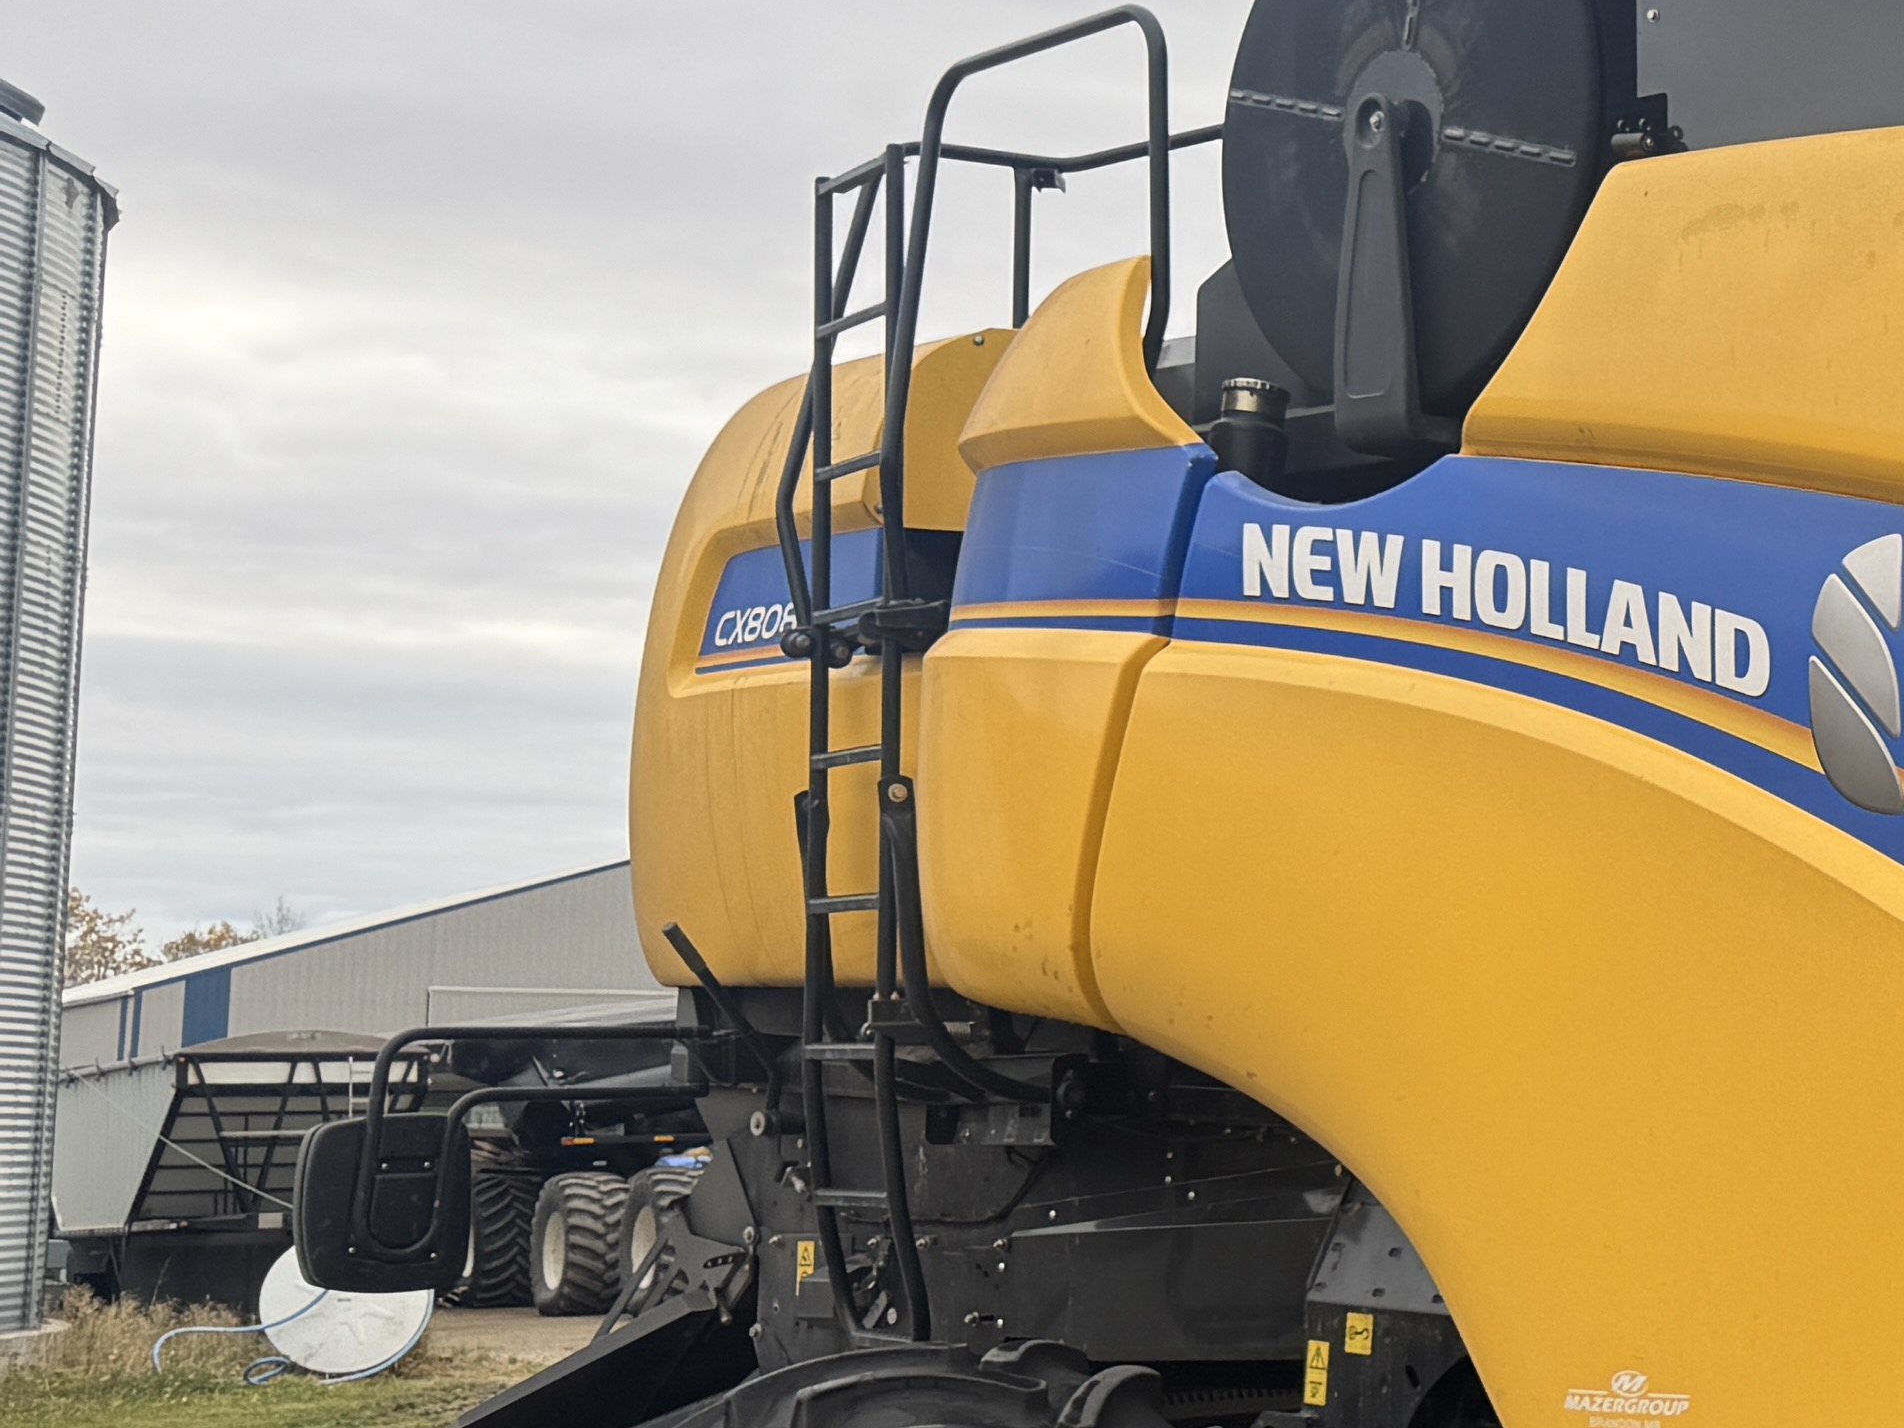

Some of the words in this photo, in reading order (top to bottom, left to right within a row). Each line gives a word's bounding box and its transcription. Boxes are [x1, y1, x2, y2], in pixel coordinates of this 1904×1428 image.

[1242, 523, 1404, 609] NEW
[1420, 538, 1771, 699] HOLLAND
[1563, 1394, 1690, 1417] MAZERGROUP
